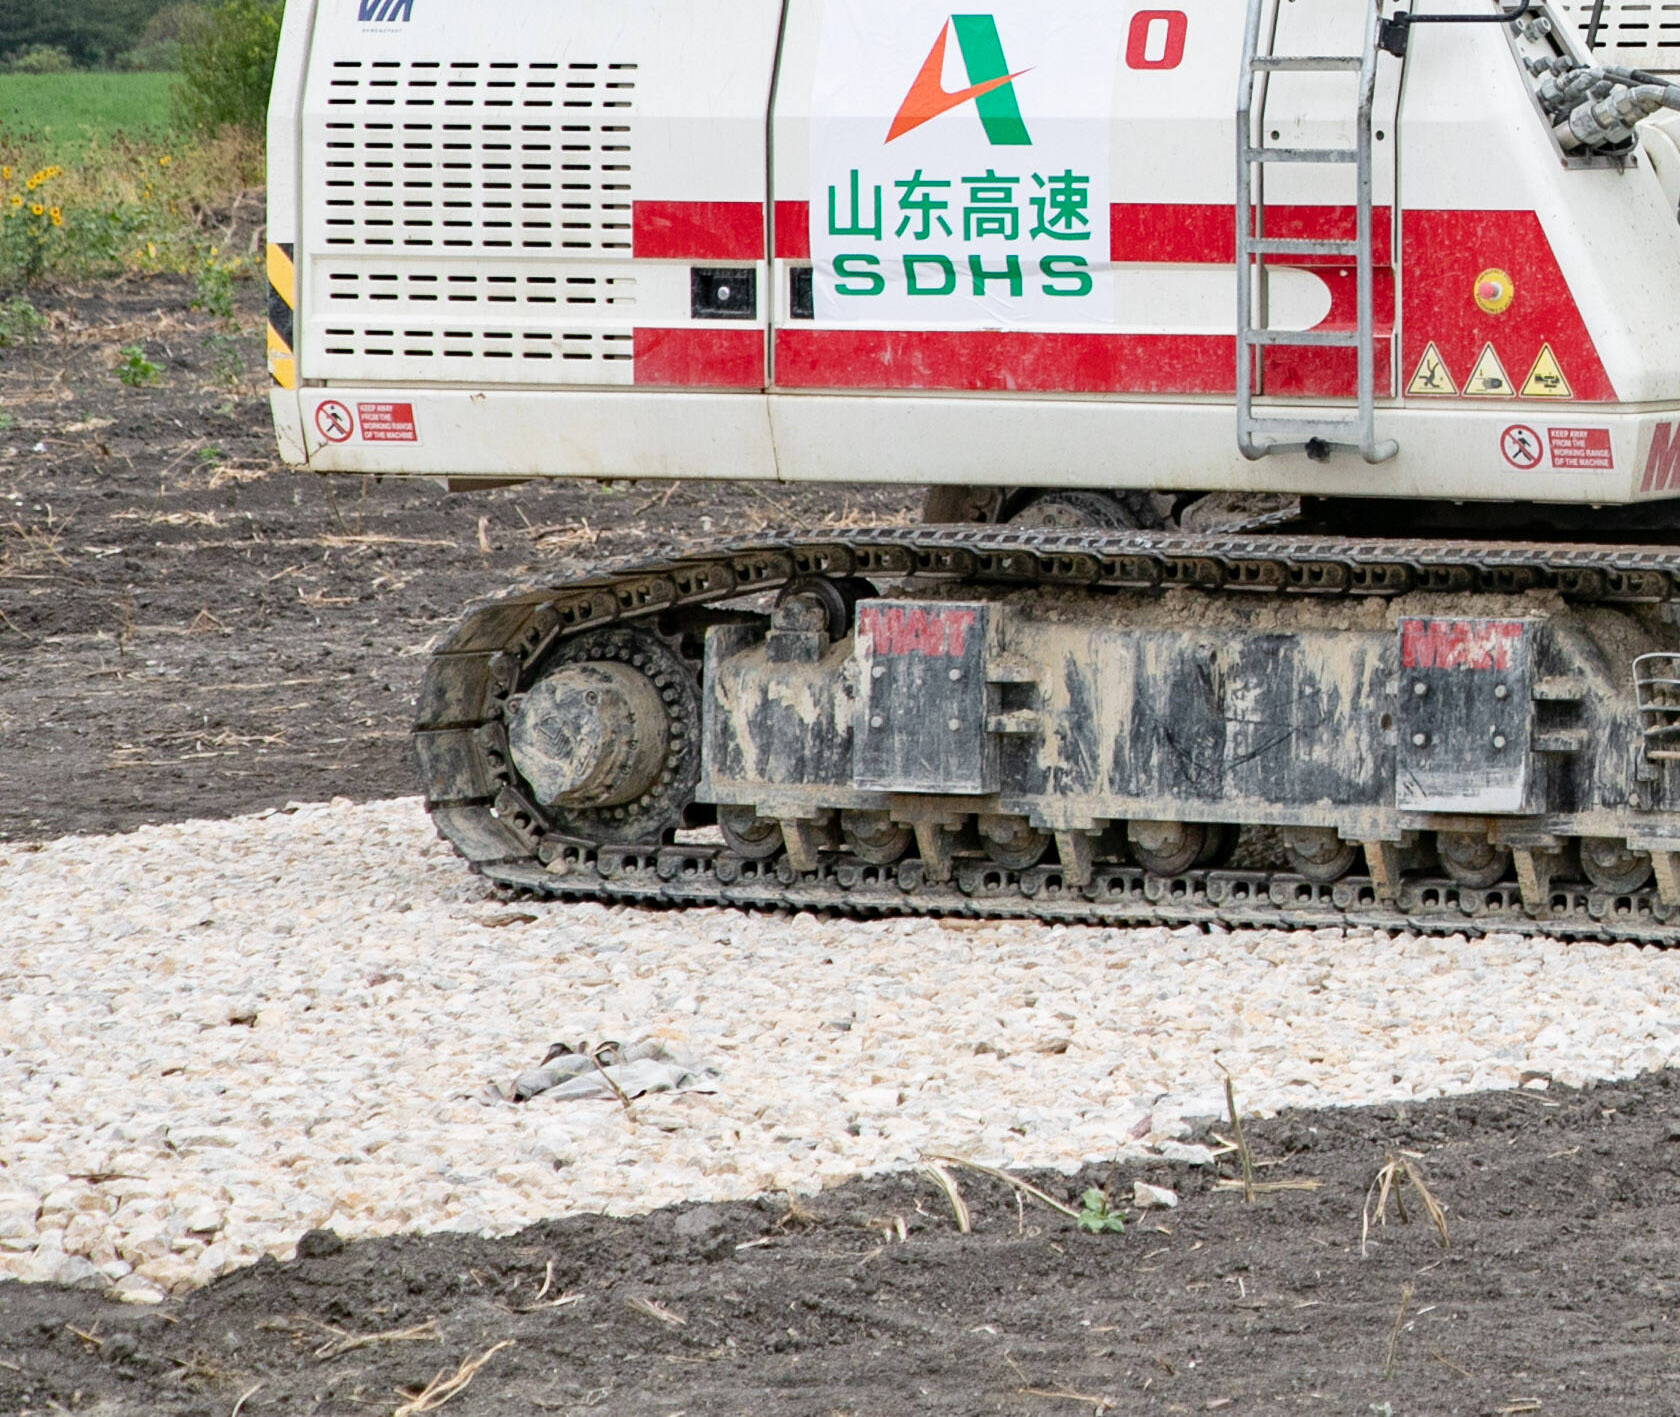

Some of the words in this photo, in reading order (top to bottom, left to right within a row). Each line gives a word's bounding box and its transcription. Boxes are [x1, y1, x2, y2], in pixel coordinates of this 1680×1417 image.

[828, 169, 1091, 241] 山东高速
[832, 253, 1093, 297] SDHS
[1553, 449, 1585, 457] WORKING
[1579, 458, 1610, 467] MACHINE
